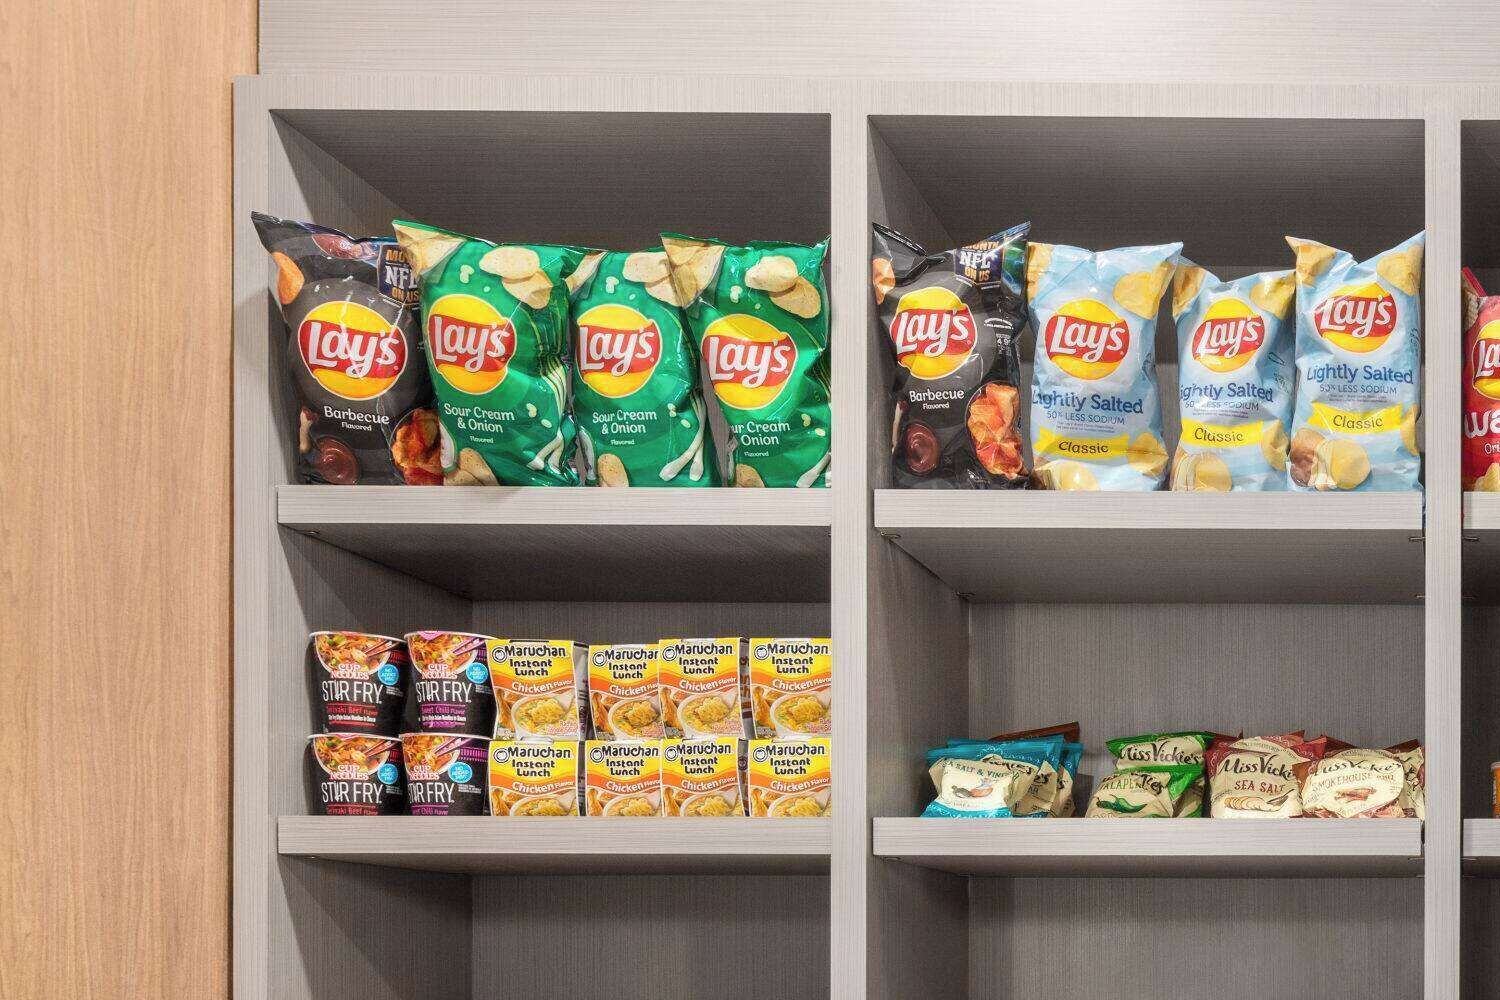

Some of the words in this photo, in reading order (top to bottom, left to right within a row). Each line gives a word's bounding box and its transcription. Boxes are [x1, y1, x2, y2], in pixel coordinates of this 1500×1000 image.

[1319, 294, 1393, 337] Lay's
[897, 309, 969, 357] Lay's
[1051, 315, 1124, 363] Lay's
[1196, 315, 1262, 358] Lay's
[308, 321, 399, 378] Lay's
[434, 316, 511, 373] Lay's
[579, 326, 655, 377] Lay's
[709, 336, 790, 388] Lay's
[1307, 365, 1358, 384] Lightly
[1363, 366, 1414, 385] Salted
[909, 388, 964, 402] Barbecue
[1180, 384, 1221, 401] ightly
[1227, 382, 1273, 403] Salted
[1361, 385, 1397, 395] SODIUM
[1091, 392, 1143, 414] Salted
[323, 405, 390, 425] Barbecue
[444, 403, 471, 417] Sour
[473, 406, 515, 421] Cream
[592, 410, 615, 424] Sour
[617, 409, 658, 422] Cream
[1088, 413, 1126, 425] SODIUM
[1333, 415, 1384, 429] Classic
[341, 421, 372, 432] Flavored
[468, 418, 504, 433] Onion
[613, 422, 647, 434] Onion
[746, 420, 791, 434] Cream
[741, 434, 780, 446] Onion
[1194, 428, 1244, 443] Classic
[1058, 440, 1109, 454] Classic
[505, 645, 566, 657] Maruchan
[675, 644, 733, 655] Maruchan
[767, 643, 829, 655] Maruchan
[510, 658, 552, 667] Instant
[608, 662, 647, 670] Instant
[679, 657, 718, 665] Instant
[772, 656, 814, 665] Instant
[331, 670, 370, 680] NOODLES
[515, 667, 549, 676] Lunch
[613, 671, 643, 679] Lunch
[684, 666, 715, 674] Lunch
[776, 665, 810, 674] Lunch
[511, 681, 552, 694] Chicken
[609, 683, 646, 695] Chicken
[679, 678, 718, 691] Chicken
[772, 678, 813, 690] Chicken
[353, 682, 383, 703] FRY
[443, 681, 472, 703] FRY
[507, 747, 571, 758] Maruchan
[601, 746, 659, 757] Maruchan
[676, 744, 731, 755] Maruchan
[766, 744, 825, 755] Maruchan
[511, 760, 555, 769] Instant
[606, 759, 645, 767] Instant
[680, 757, 718, 765] Instant
[770, 757, 811, 766] Instant
[1221, 756, 1257, 774] Miss
[1259, 754, 1295, 780] Vicki
[517, 768, 551, 777] Lunch
[610, 768, 640, 776] Lunch
[685, 766, 715, 774] Lunch
[774, 766, 807, 775] Lunch
[511, 781, 554, 793] Chicken
[606, 781, 643, 792] Chicken
[680, 779, 718, 791] Chicken
[770, 779, 811, 791] Chicken
[1234, 780, 1255, 791] SEA
[1260, 782, 1285, 794] SALT
[353, 782, 383, 803] FRY
[427, 782, 455, 803] FRY
